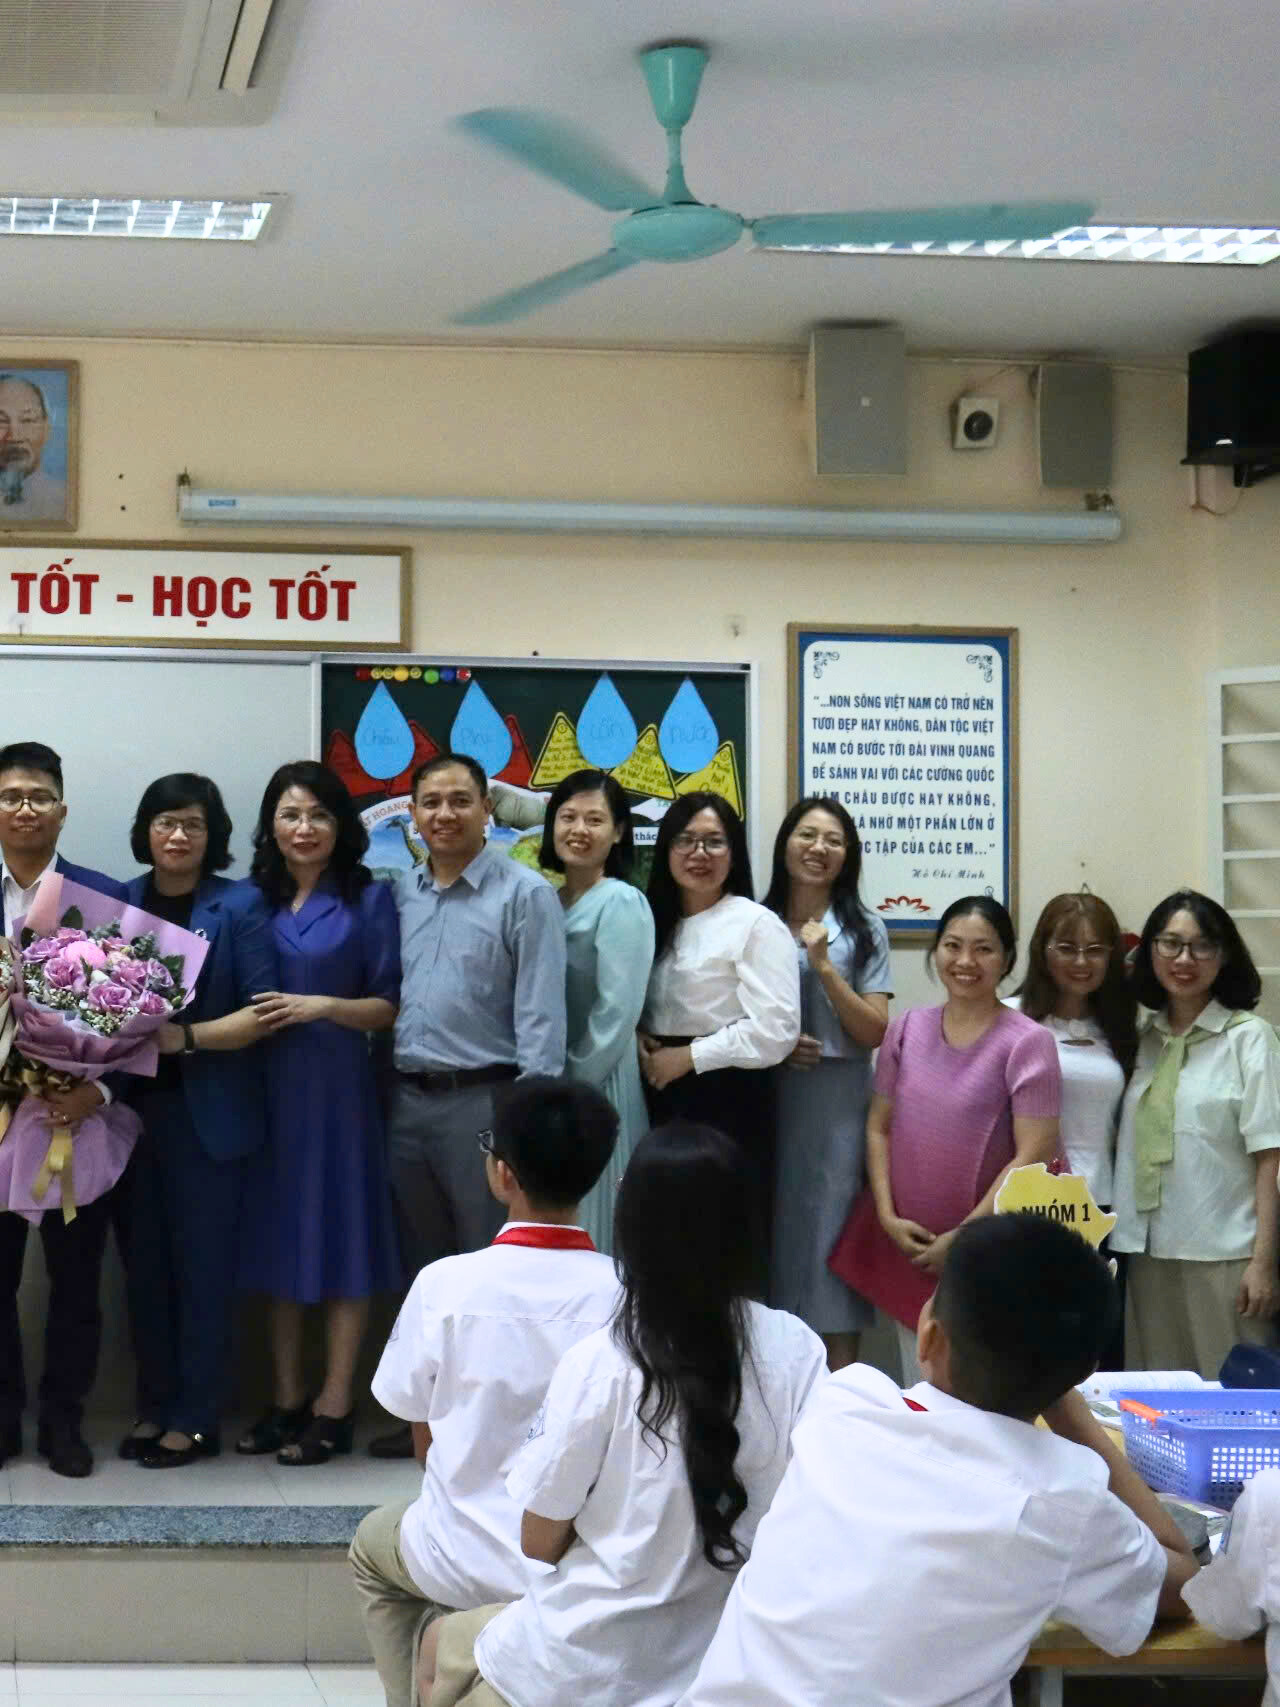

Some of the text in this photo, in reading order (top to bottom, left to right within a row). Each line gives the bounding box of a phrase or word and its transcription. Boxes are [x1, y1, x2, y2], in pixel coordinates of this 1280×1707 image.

[10, 558, 100, 616] TỐT
[116, 594, 134, 603] -
[152, 574, 251, 627] HỌC
[269, 564, 357, 621] TỐT
[854, 693, 881, 709] SÔNG
[884, 694, 905, 711] VIỆT
[908, 697, 931, 710] NAM
[973, 695, 994, 711] NÊN
[838, 718, 858, 733] ĐẸP
[861, 719, 881, 731] HAY
[950, 717, 969, 736] TỘC
[972, 718, 994, 736] VIỆT
[812, 742, 836, 755] NAM
[857, 740, 885, 756] BƯỚC
[889, 740, 905, 756] TỚI
[929, 744, 955, 757] VINH
[958, 744, 995, 758] QUANG
[829, 765, 857, 780] SÁNH
[860, 767, 877, 780] VAI
[881, 765, 898, 780] VỚI
[902, 765, 923, 780] CÁC
[966, 765, 995, 782] QUỐC
[844, 790, 877, 805] CHÂU
[881, 792, 915, 809] ĐƯỢC
[919, 793, 943, 806] HAY
[897, 815, 921, 832] MỘT
[961, 814, 983, 830] LỚN
[875, 840, 897, 857] TẬP
[901, 836, 924, 854] CỦA
[929, 839, 952, 854] CÁC
[1082, 1203, 1091, 1222] 1
